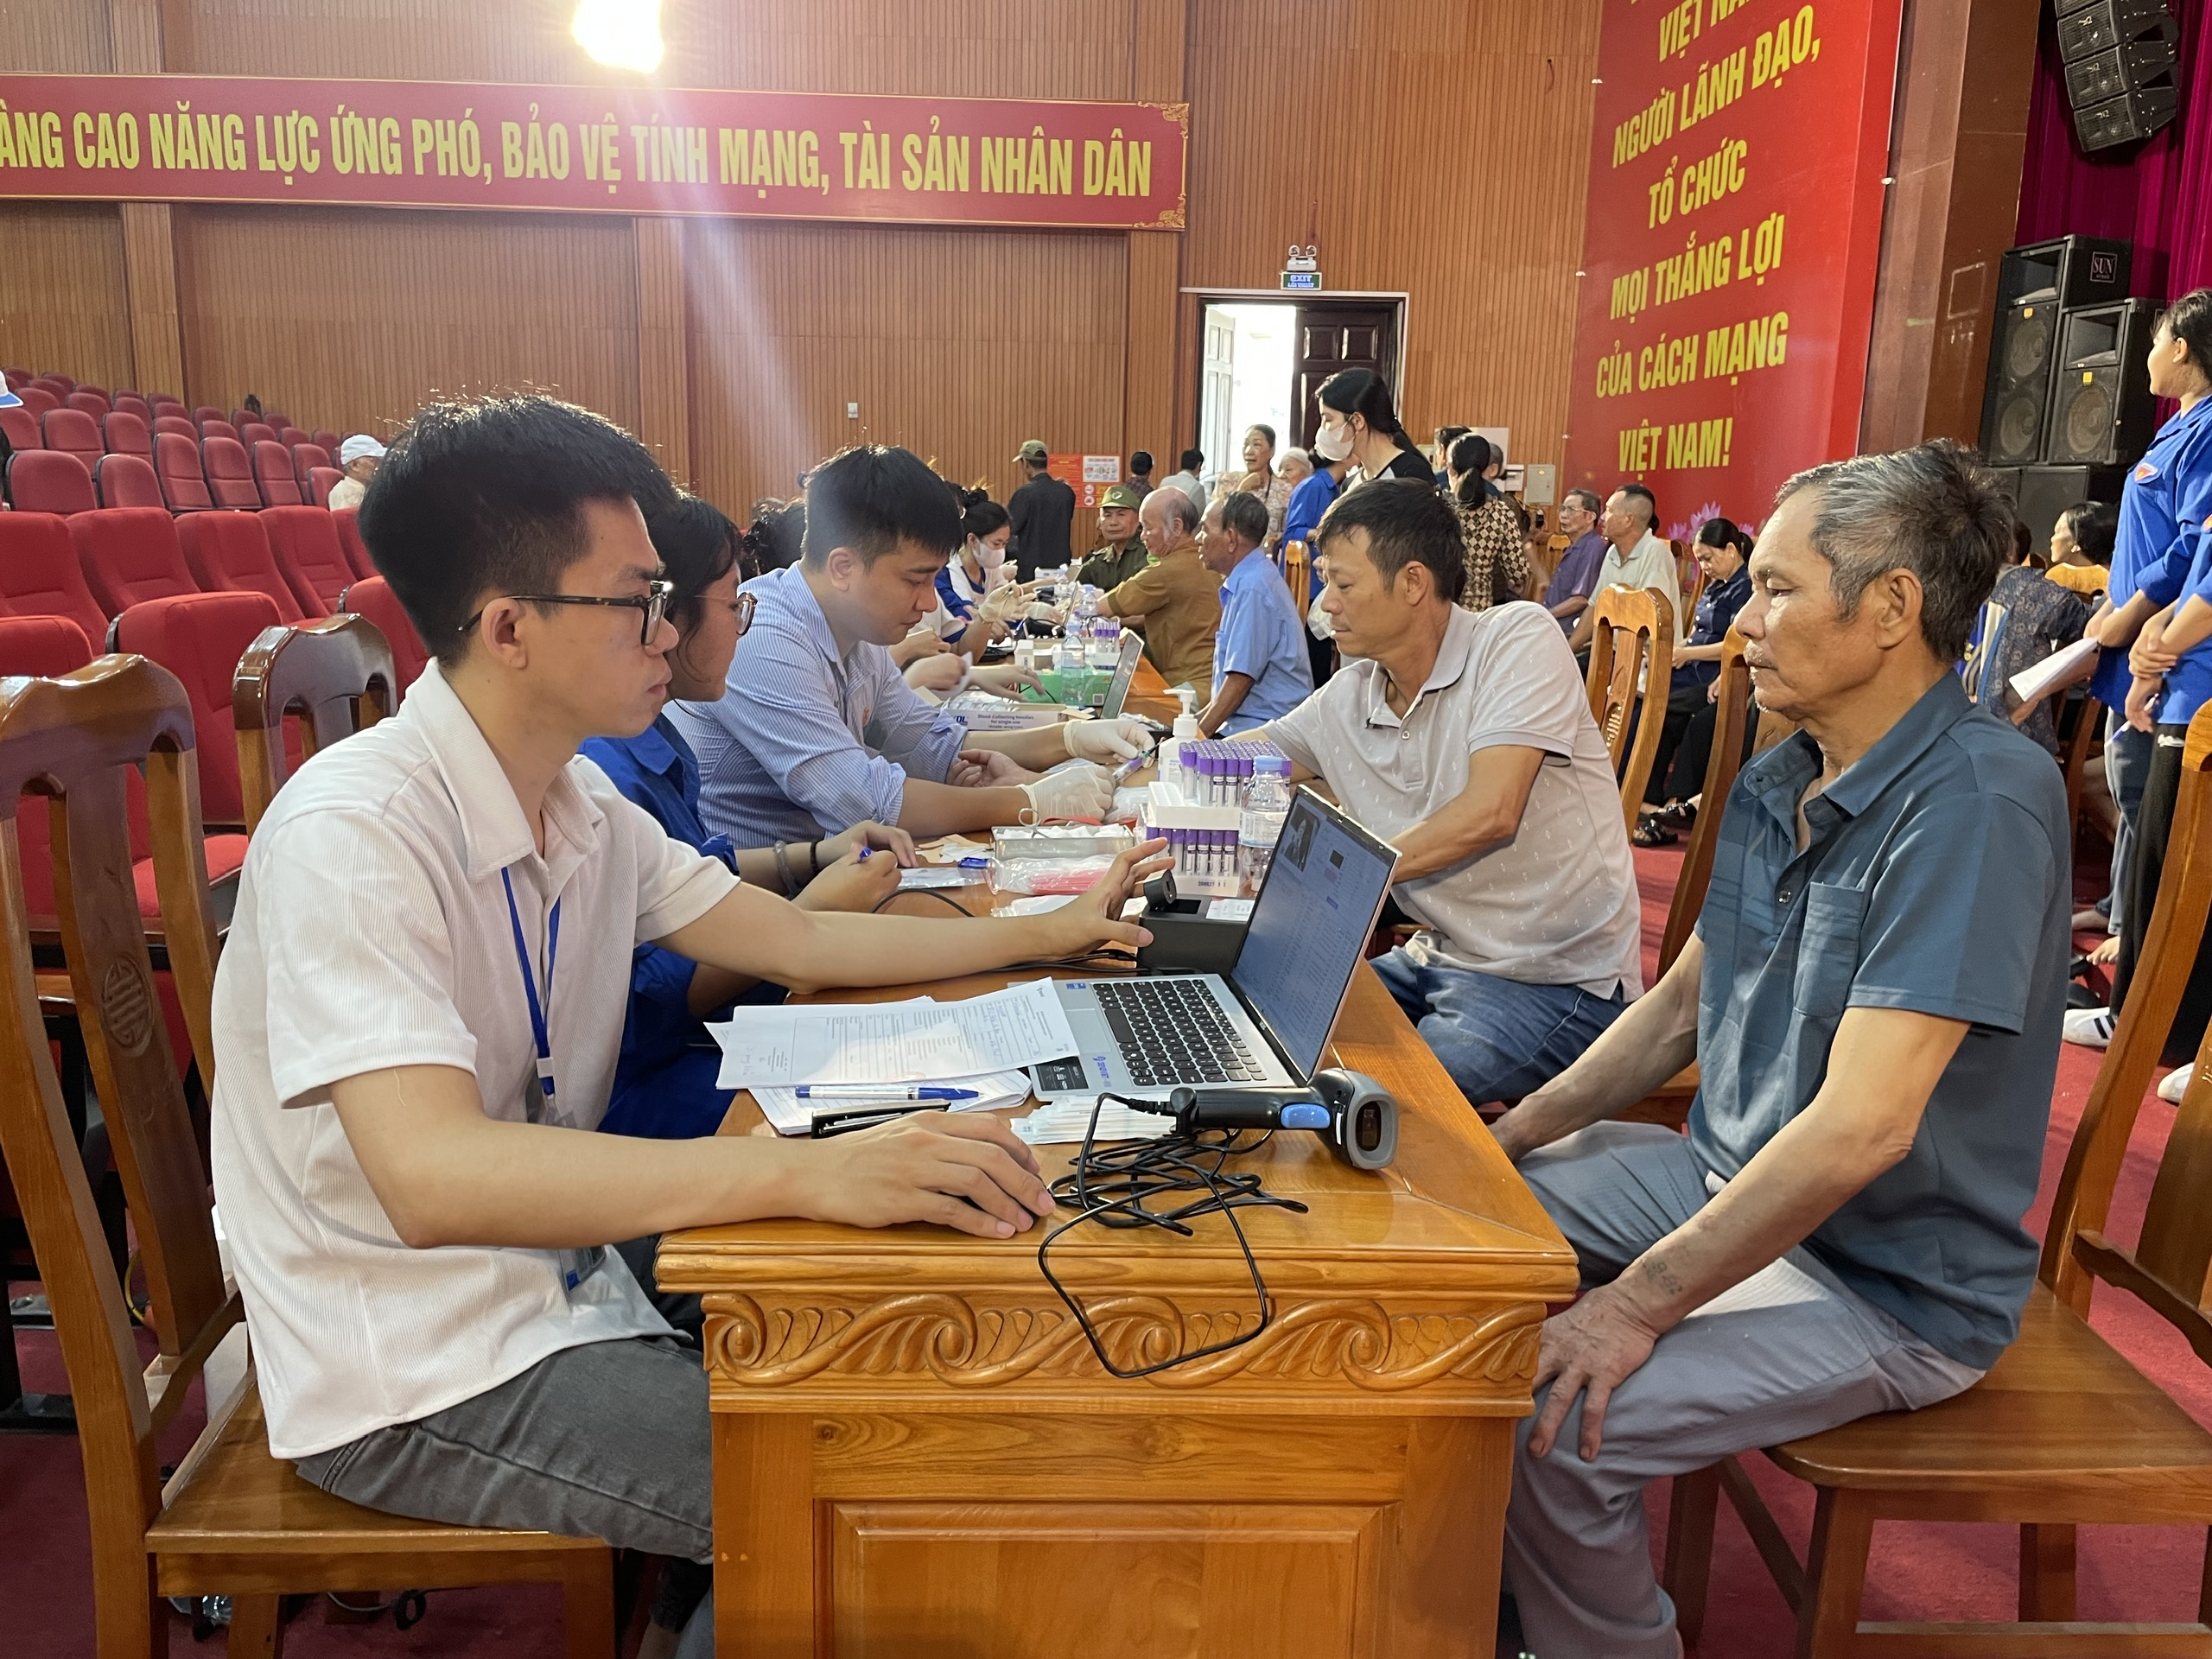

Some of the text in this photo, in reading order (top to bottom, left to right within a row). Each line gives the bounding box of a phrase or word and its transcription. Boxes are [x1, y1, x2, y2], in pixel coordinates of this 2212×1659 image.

[1612, 4, 1821, 169] NGƯỜI LÃNH ĐẠO,
[73, 111, 140, 169] CAO
[149, 101, 246, 171] NĂNG
[256, 110, 321, 186] LỰC
[330, 104, 403, 175] ỨNG
[411, 108, 493, 185] PHÓ,
[502, 103, 569, 181] BẢO
[579, 113, 621, 194] VỆ
[630, 113, 709, 185] TÍNH
[719, 127, 830, 199] MẠNG,
[839, 120, 891, 191] TÀI
[901, 114, 970, 194] SẢN
[981, 125, 1073, 196] NHÂN
[1083, 127, 1152, 198] DÂN
[1649, 137, 1748, 230] TỔ CHỨC
[1290, 274, 1313, 283] EXIT
[1610, 212, 1786, 323] MỌI THẮNG LỢI
[2093, 257, 2115, 274] SUN
[1595, 311, 1790, 399] CỦA CÁCH MẠNG
[1618, 416, 1734, 481] VIỆT NAM!
